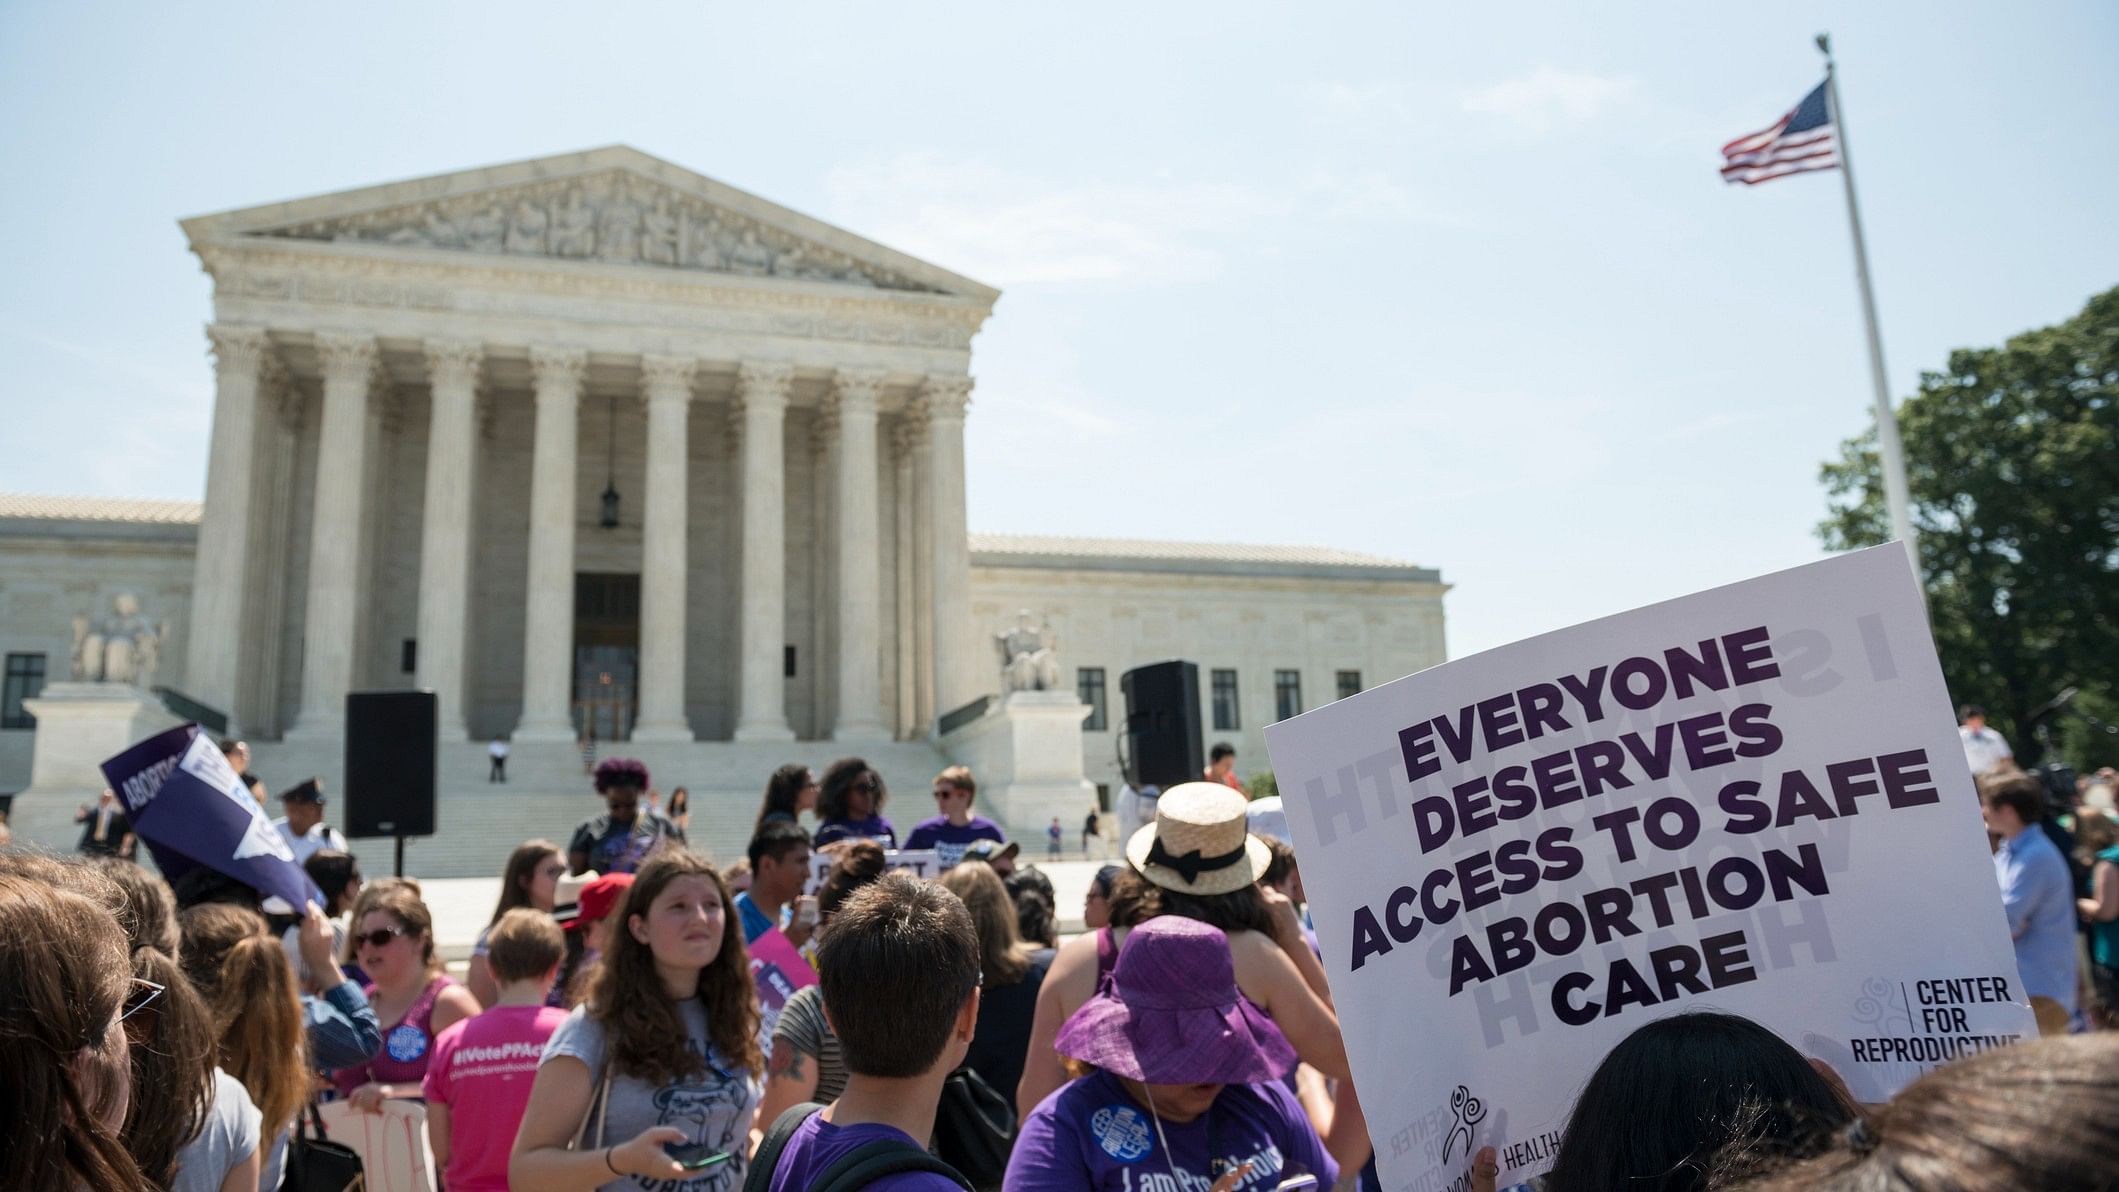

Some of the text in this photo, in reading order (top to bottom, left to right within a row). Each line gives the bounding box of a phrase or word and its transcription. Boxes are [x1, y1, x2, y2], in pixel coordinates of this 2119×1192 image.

[1397, 625, 1782, 783] EVERYONE
[1411, 703, 1785, 855] DESERVES
[1350, 826, 1585, 972] ACCESS
[1592, 796, 1702, 864] TO
[1717, 748, 1941, 835] SAFE
[1448, 842, 1831, 998] ABORTION
[1550, 929, 1758, 1027] CARE
[1916, 976, 2013, 1006] CENTER
[1921, 1007, 1971, 1034] FOR
[1503, 1130, 1562, 1171] HEALTH
